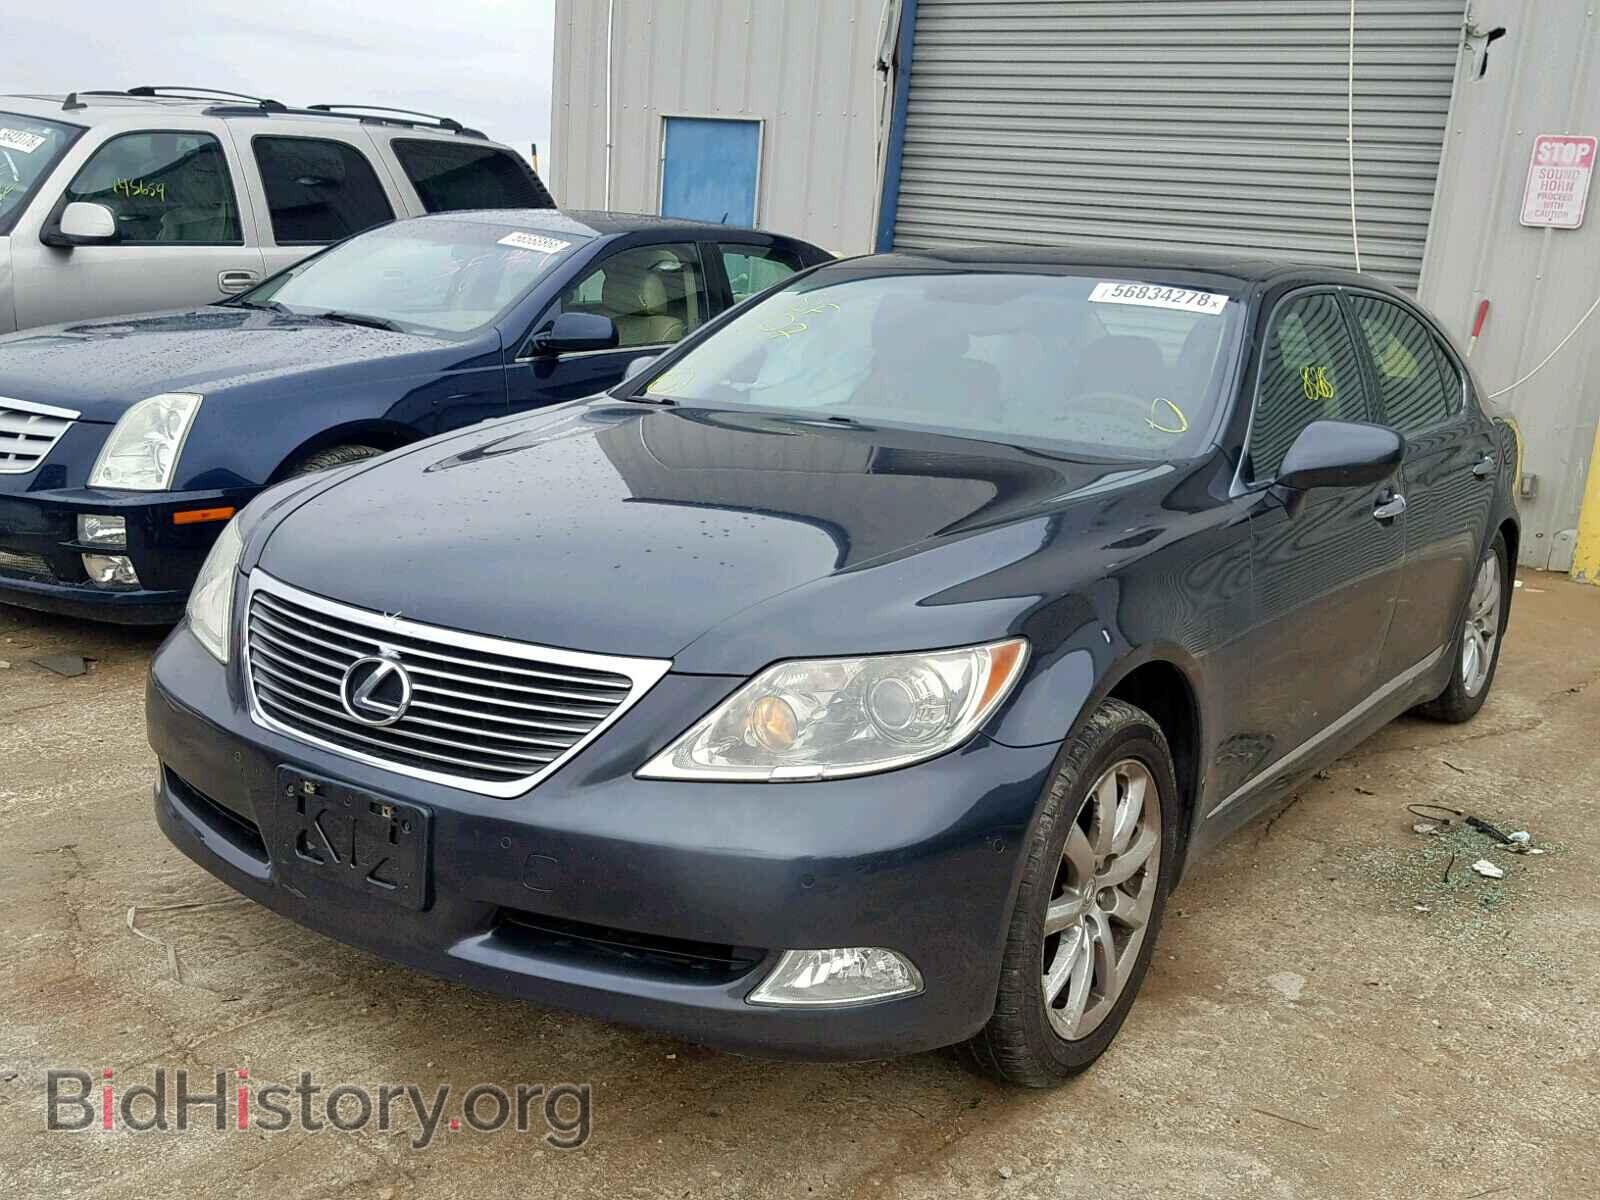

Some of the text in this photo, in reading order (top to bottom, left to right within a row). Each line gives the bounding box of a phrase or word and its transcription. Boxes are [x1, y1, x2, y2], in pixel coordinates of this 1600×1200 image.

[1537, 142, 1590, 162] STOP
[1539, 168, 1580, 180] SOUND
[1540, 180, 1575, 191] HORN
[1111, 284, 1211, 306] 56834278
